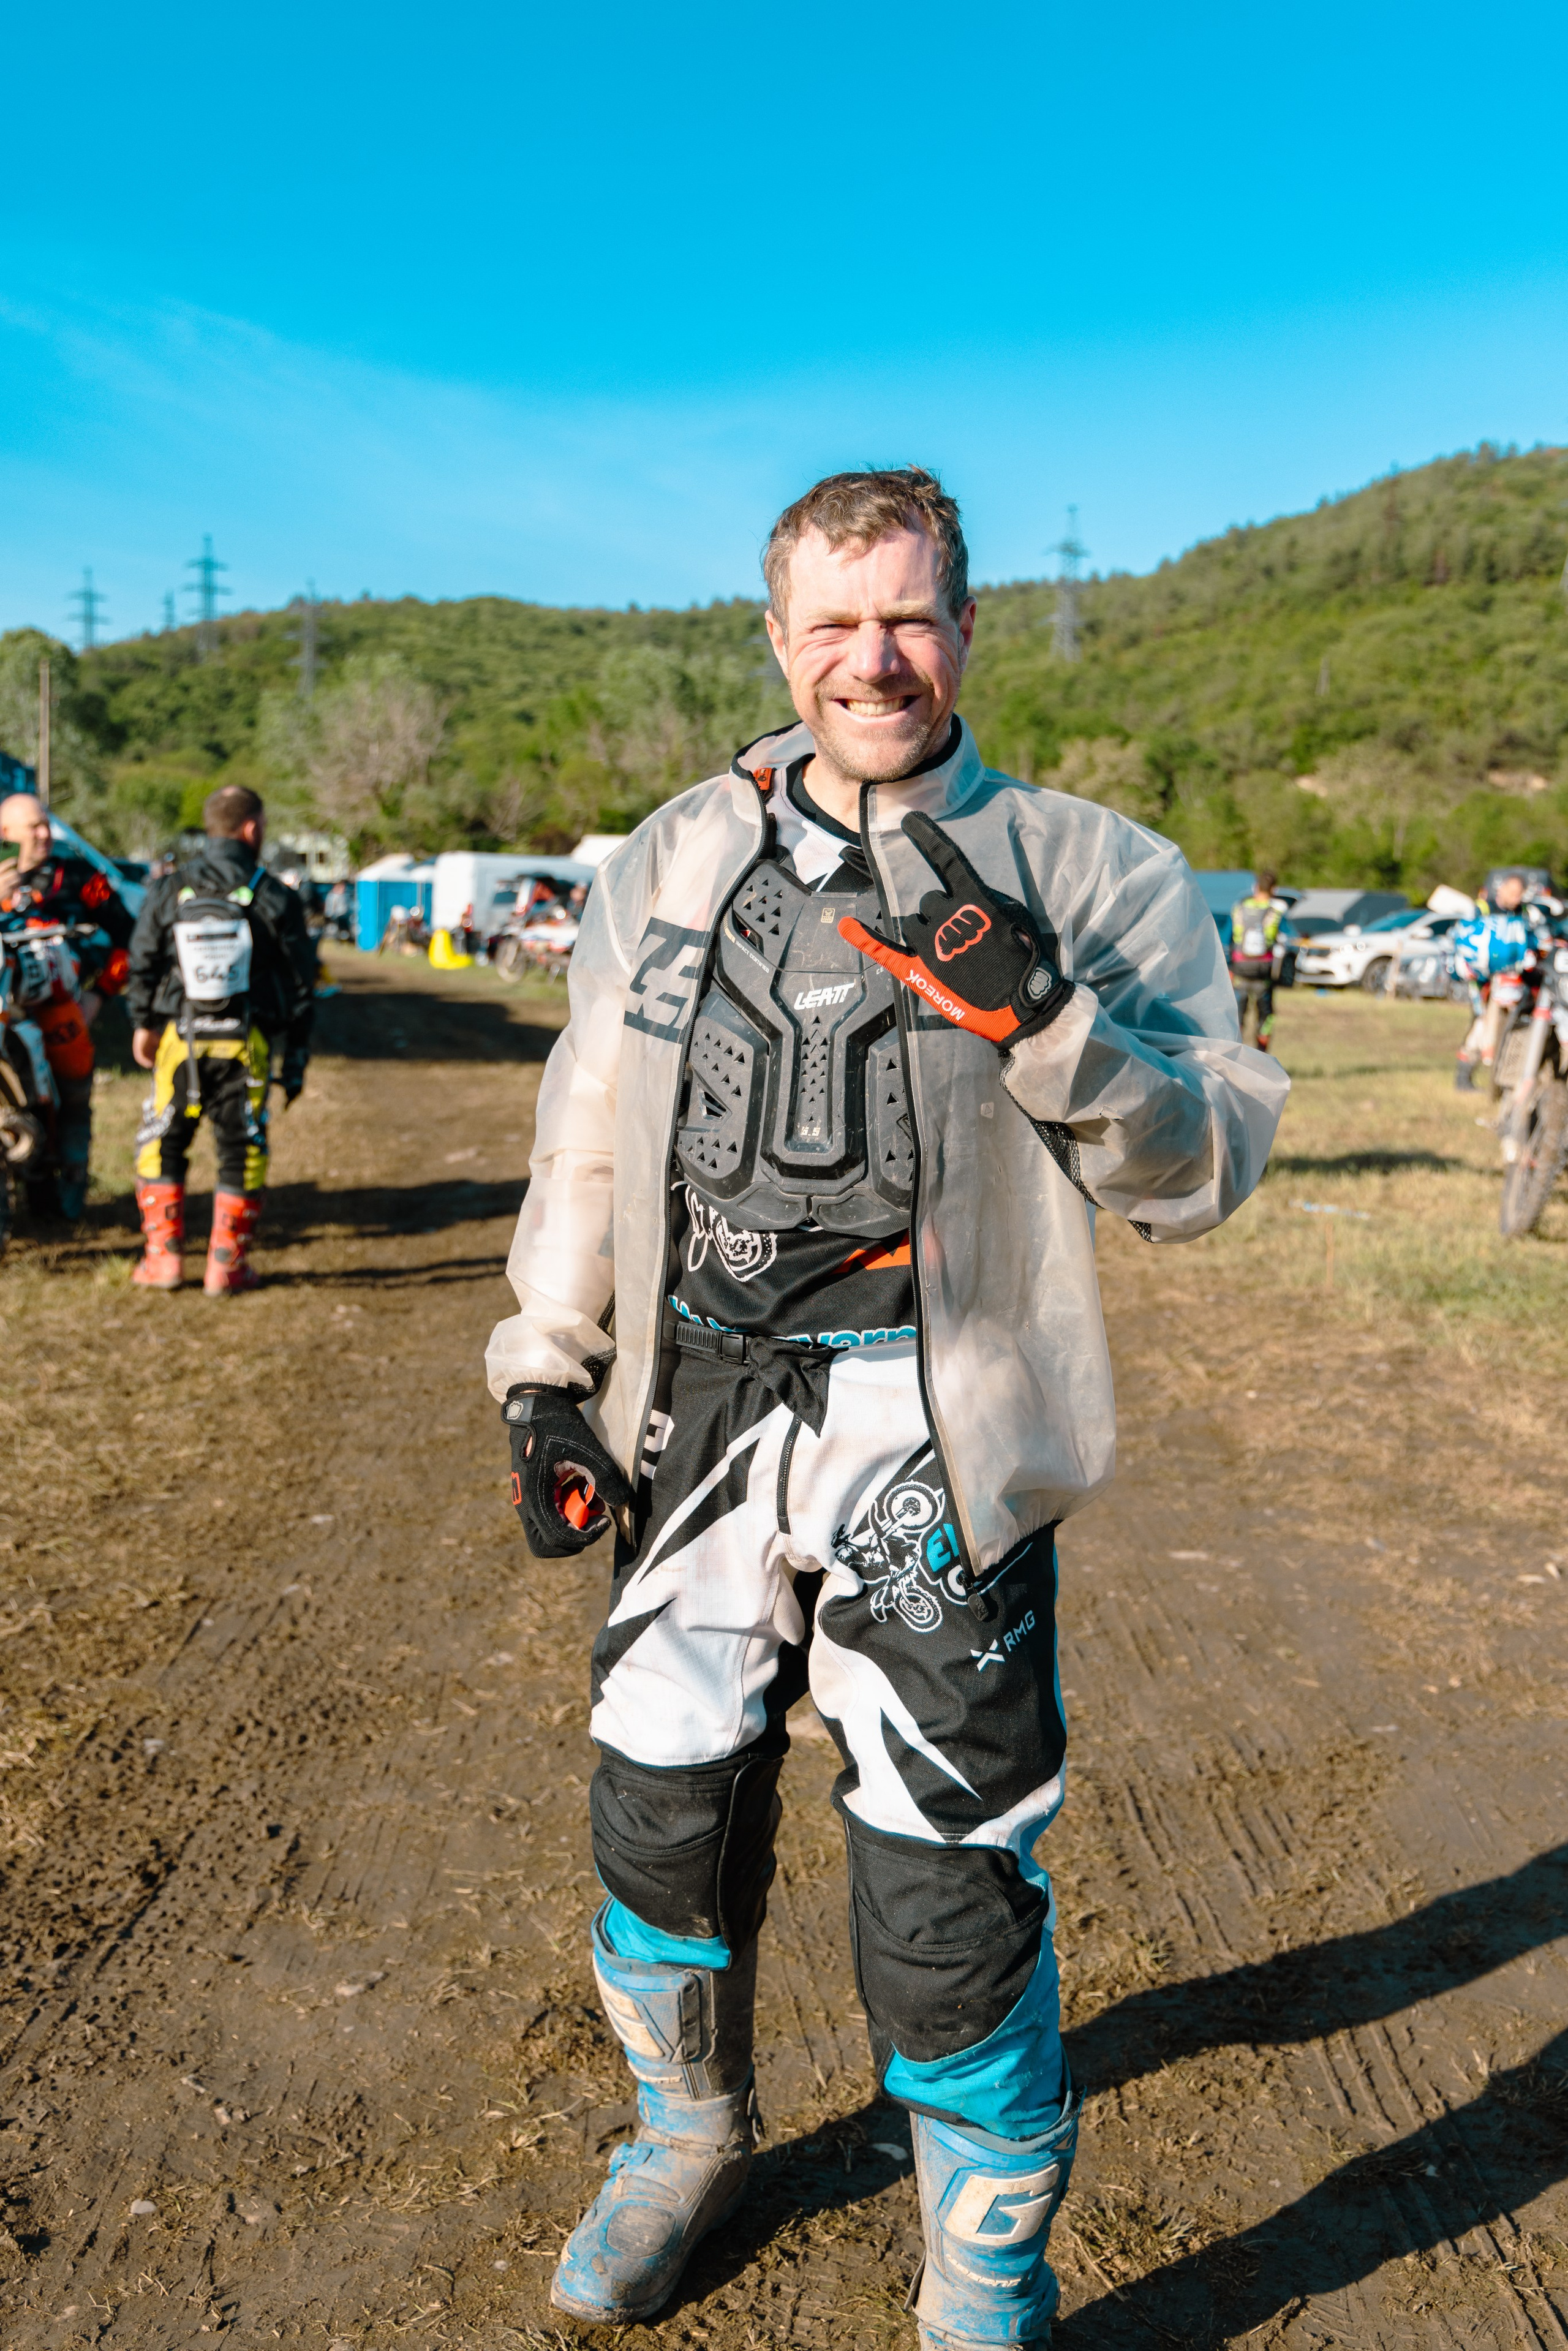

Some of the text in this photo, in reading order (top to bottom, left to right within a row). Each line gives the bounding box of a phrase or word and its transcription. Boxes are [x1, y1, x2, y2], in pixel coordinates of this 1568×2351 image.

[735, 940, 769, 973] IMPACT CERTIFIED
[794, 983, 854, 1010] LEATT
[905, 969, 965, 1021] MOREOK
[1003, 1610, 1035, 1653] RMG
